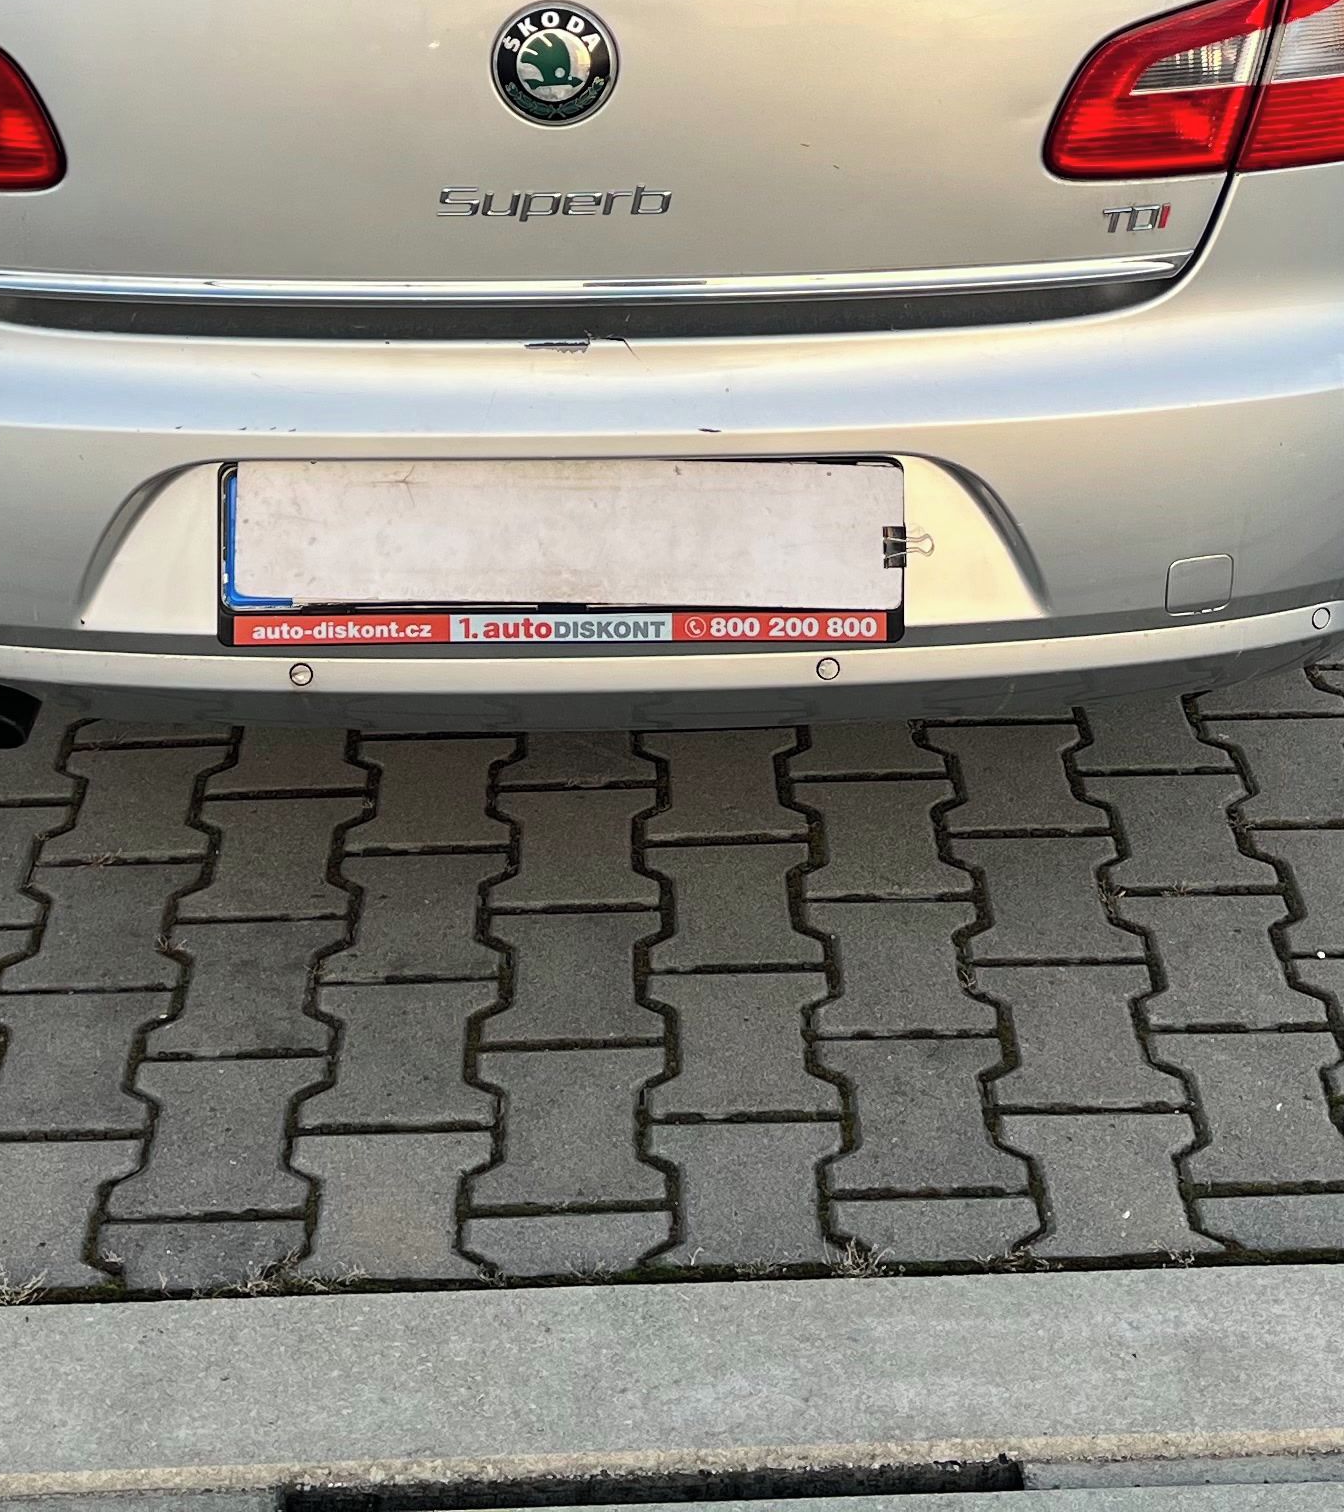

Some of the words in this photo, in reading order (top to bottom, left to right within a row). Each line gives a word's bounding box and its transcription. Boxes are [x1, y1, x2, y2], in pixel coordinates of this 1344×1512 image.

[436, 182, 673, 223] Superb
[1102, 202, 1171, 234] TDI
[251, 620, 433, 641] auto-diskont.cz
[709, 616, 761, 638] 800
[768, 616, 820, 638] 200
[826, 615, 878, 638] 800
